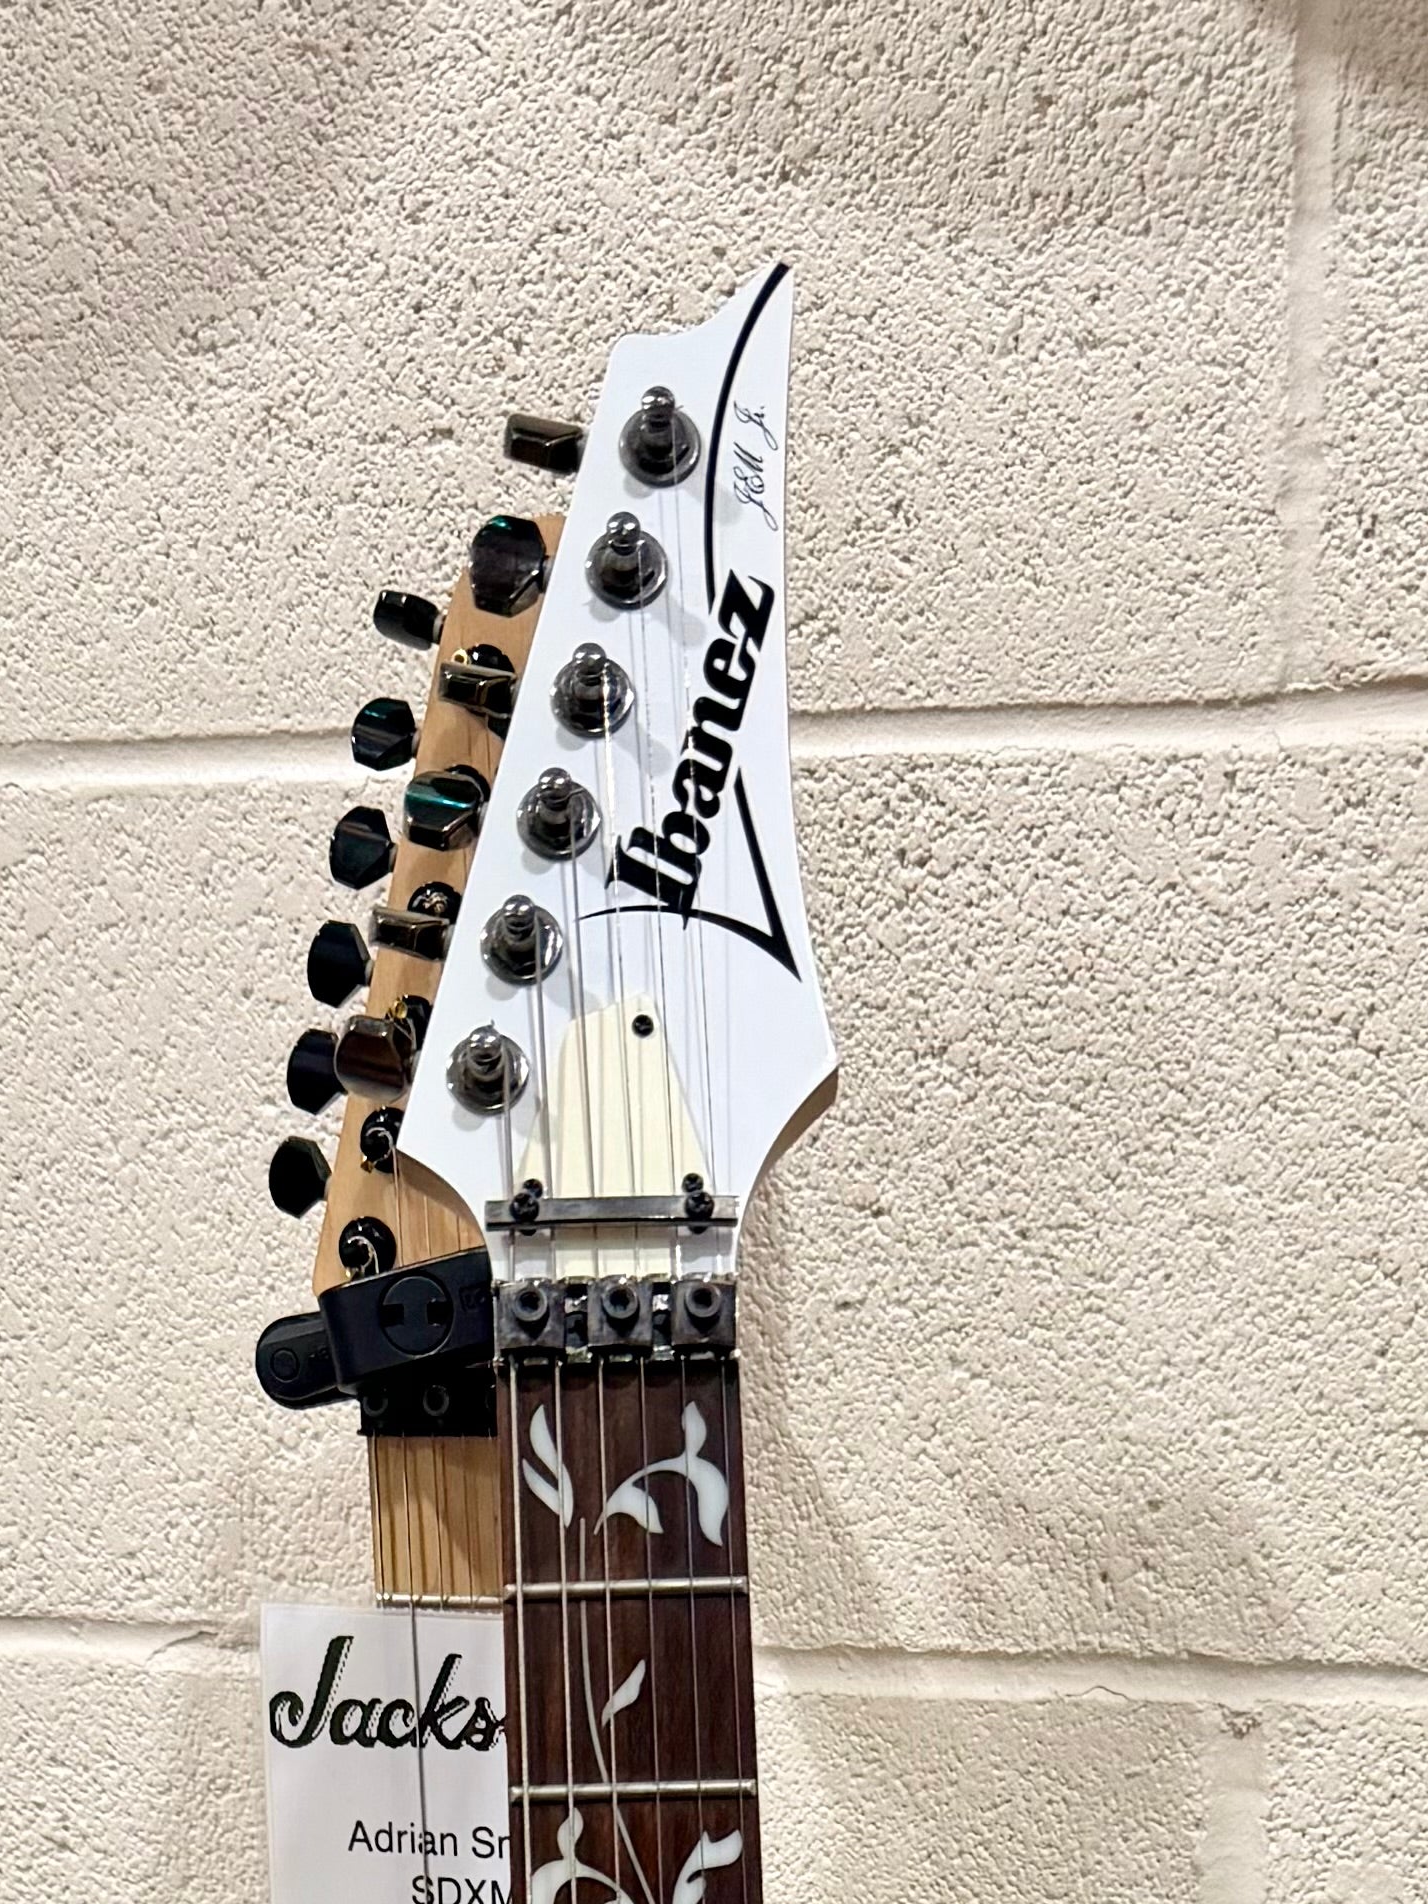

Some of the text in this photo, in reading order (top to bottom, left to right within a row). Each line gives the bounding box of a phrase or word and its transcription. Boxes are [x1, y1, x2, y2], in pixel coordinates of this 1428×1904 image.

[605, 568, 776, 931] Ibanez
[269, 1635, 507, 1752] Jacks
[348, 1819, 458, 1857] Adrian
